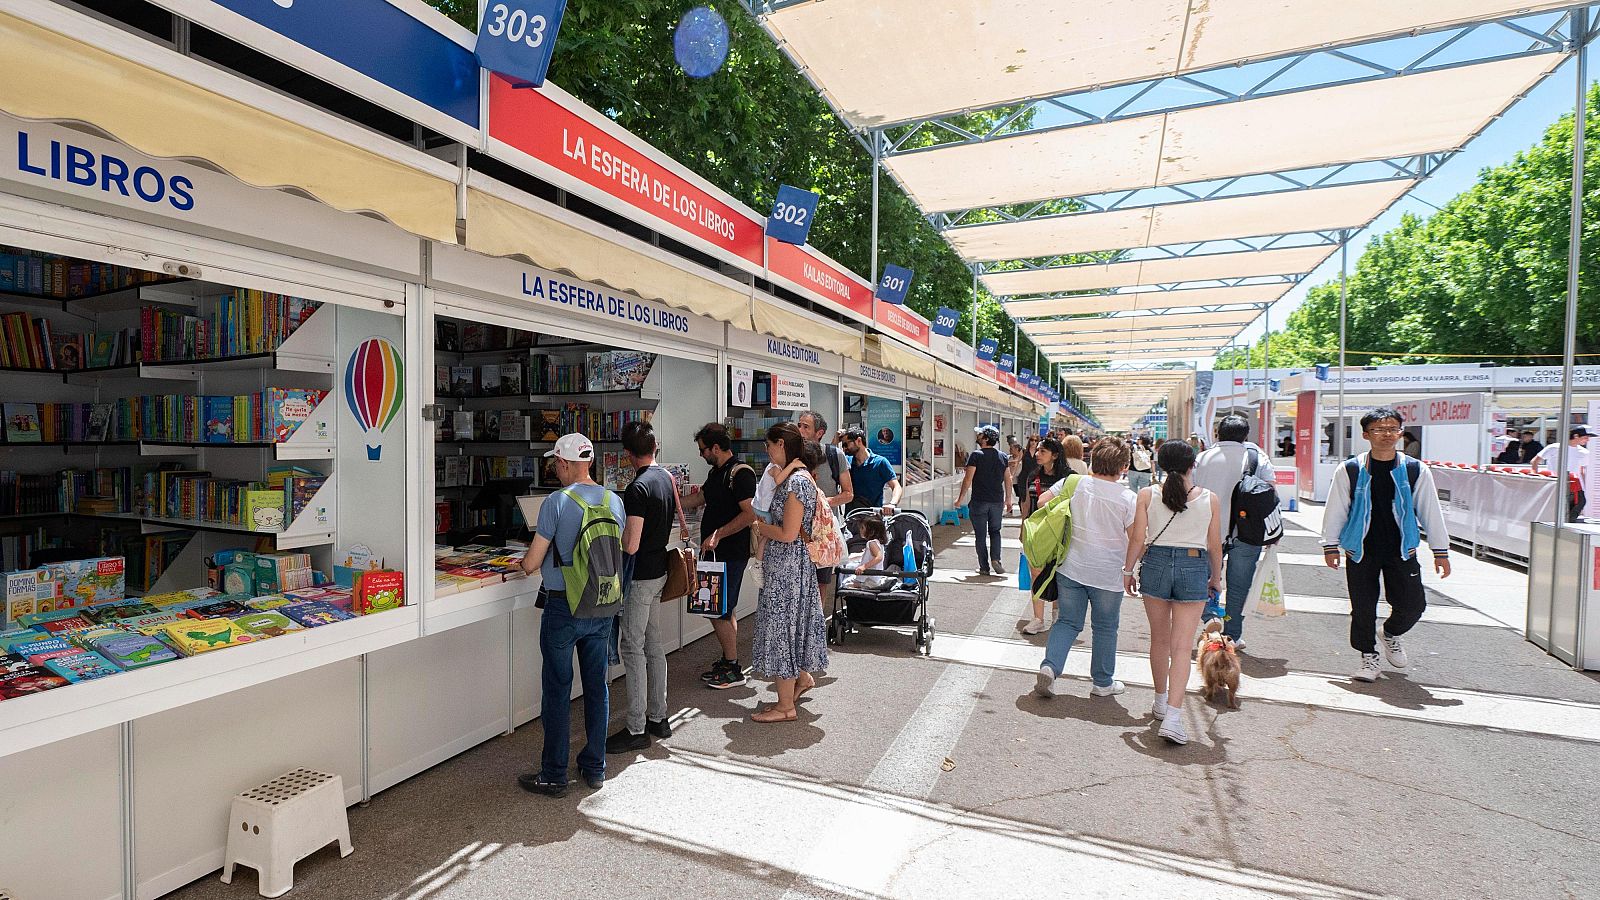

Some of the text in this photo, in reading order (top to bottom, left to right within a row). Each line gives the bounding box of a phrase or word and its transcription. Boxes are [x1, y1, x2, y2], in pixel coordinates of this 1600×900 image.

[487, 4, 547, 48] 303
[18, 131, 195, 211] LIBROS
[562, 128, 735, 241] LA ESFERA DE LOS LIBROS
[773, 202, 805, 226] 302
[803, 263, 851, 300] KAILAS EDITORIAL
[882, 275, 905, 293] 301
[522, 272, 688, 333] LA ESFERA DE LOS LIBROS
[936, 315, 955, 328] 300
[767, 338, 820, 365] KAILAS EDITORIAL
[980, 344, 994, 354] 299
[1000, 358, 1013, 368] 298
[8, 584, 36, 595] FORMAS
